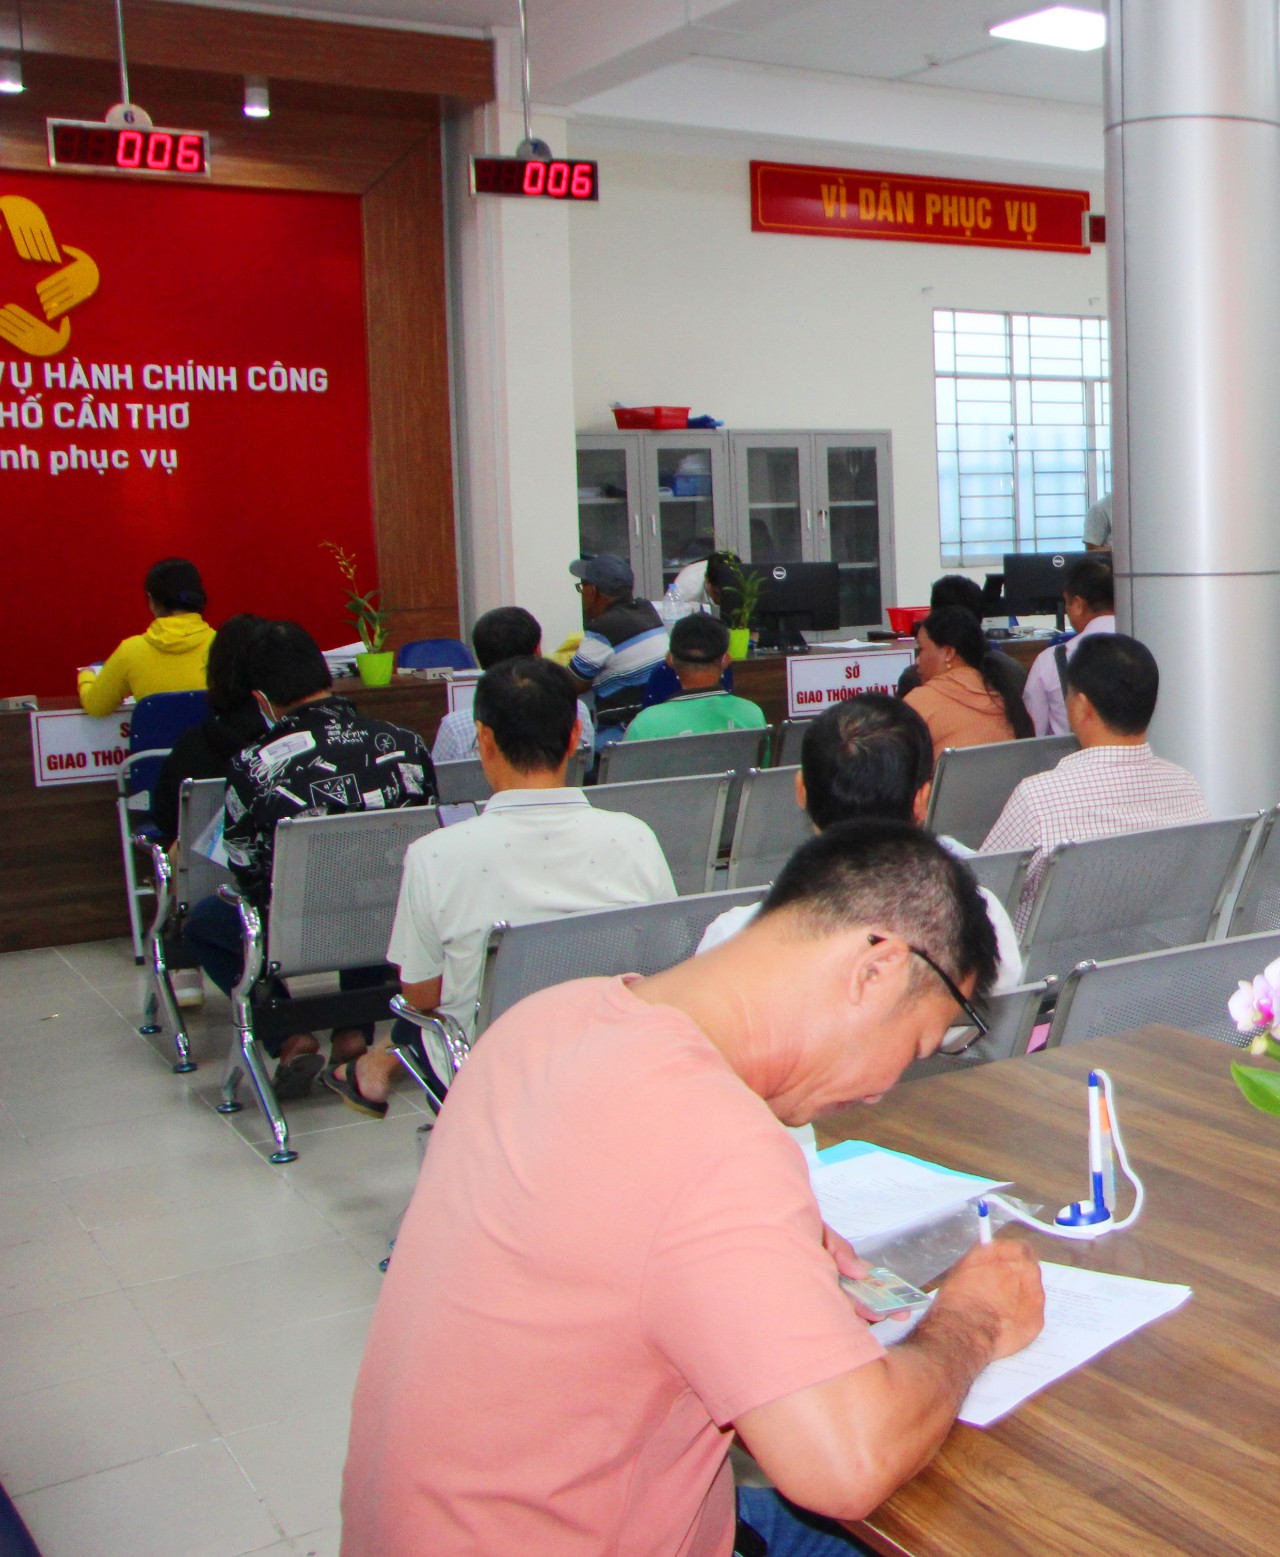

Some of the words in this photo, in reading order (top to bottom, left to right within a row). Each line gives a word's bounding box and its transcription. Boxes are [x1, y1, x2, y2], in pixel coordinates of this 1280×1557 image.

[116, 129, 201, 172] 006
[523, 160, 593, 198] 006
[821, 178, 847, 218] VÌ
[858, 182, 914, 225] DÂN
[926, 193, 992, 236] PHỤC
[1005, 200, 1037, 241] VỤ
[0, 361, 33, 395] Ụ
[44, 357, 133, 390] HÀNH
[143, 360, 237, 391] CHÍNH
[247, 361, 328, 392] CÔNG
[53, 394, 119, 429] CẦN
[125, 402, 190, 429] THƠ
[50, 445, 129, 475] phục
[140, 449, 178, 475] vụ
[845, 661, 860, 679] SỞ
[797, 690, 823, 704] GIAO
[46, 751, 87, 771] GIAO
[92, 746, 131, 766] THÔ
